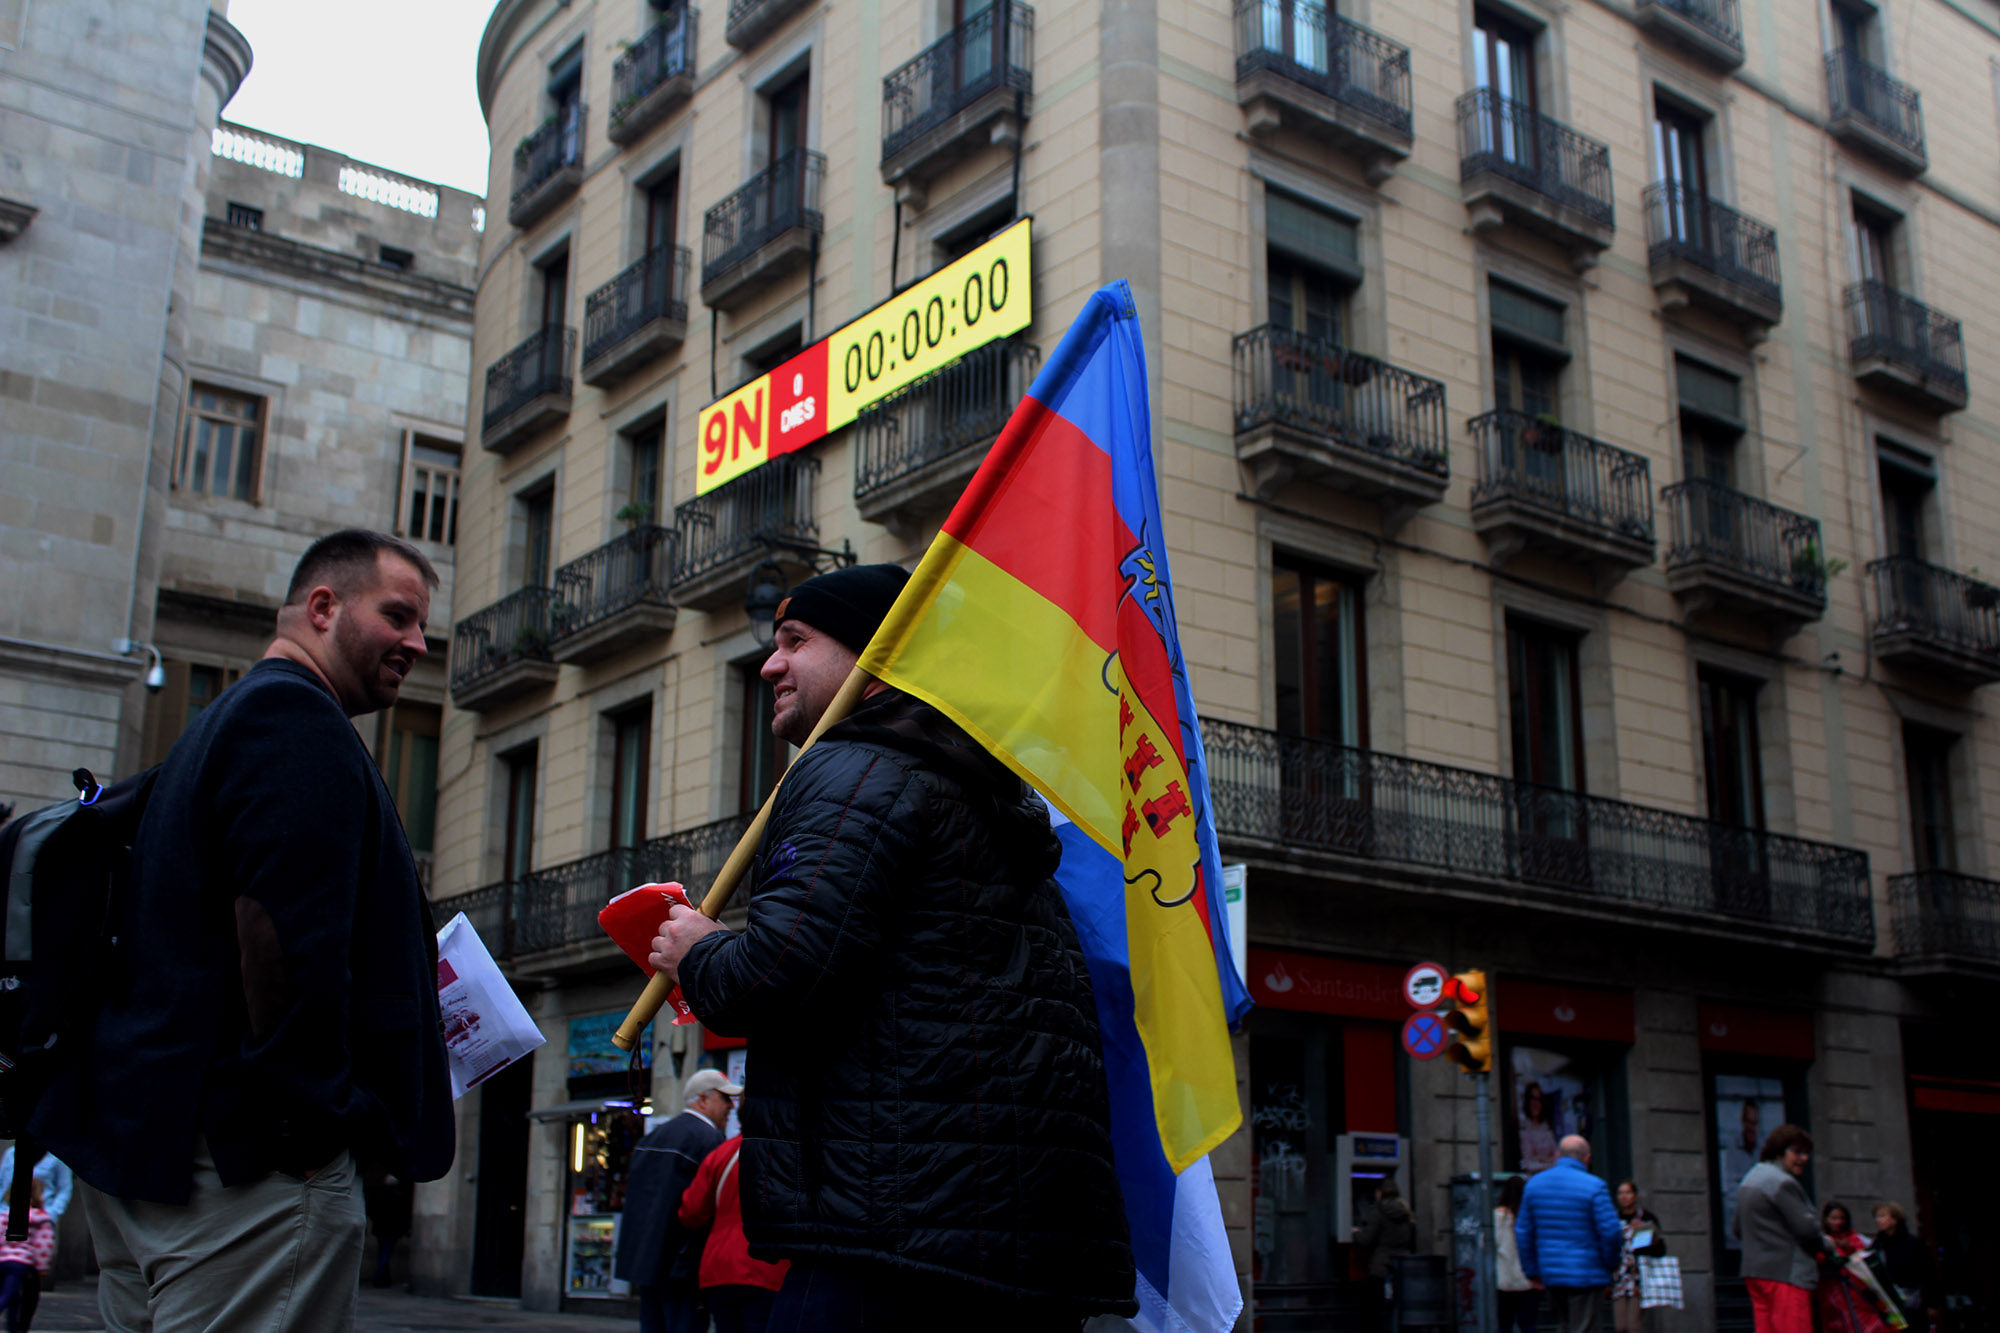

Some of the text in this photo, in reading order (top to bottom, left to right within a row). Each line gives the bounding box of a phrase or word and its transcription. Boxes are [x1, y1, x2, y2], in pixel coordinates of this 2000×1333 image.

[845, 257, 1008, 393] 00:00:00
[792, 373, 804, 397] 0
[704, 388, 763, 475] 9N
[780, 396, 816, 434] DIES
[1297, 967, 1402, 1004] Santander
